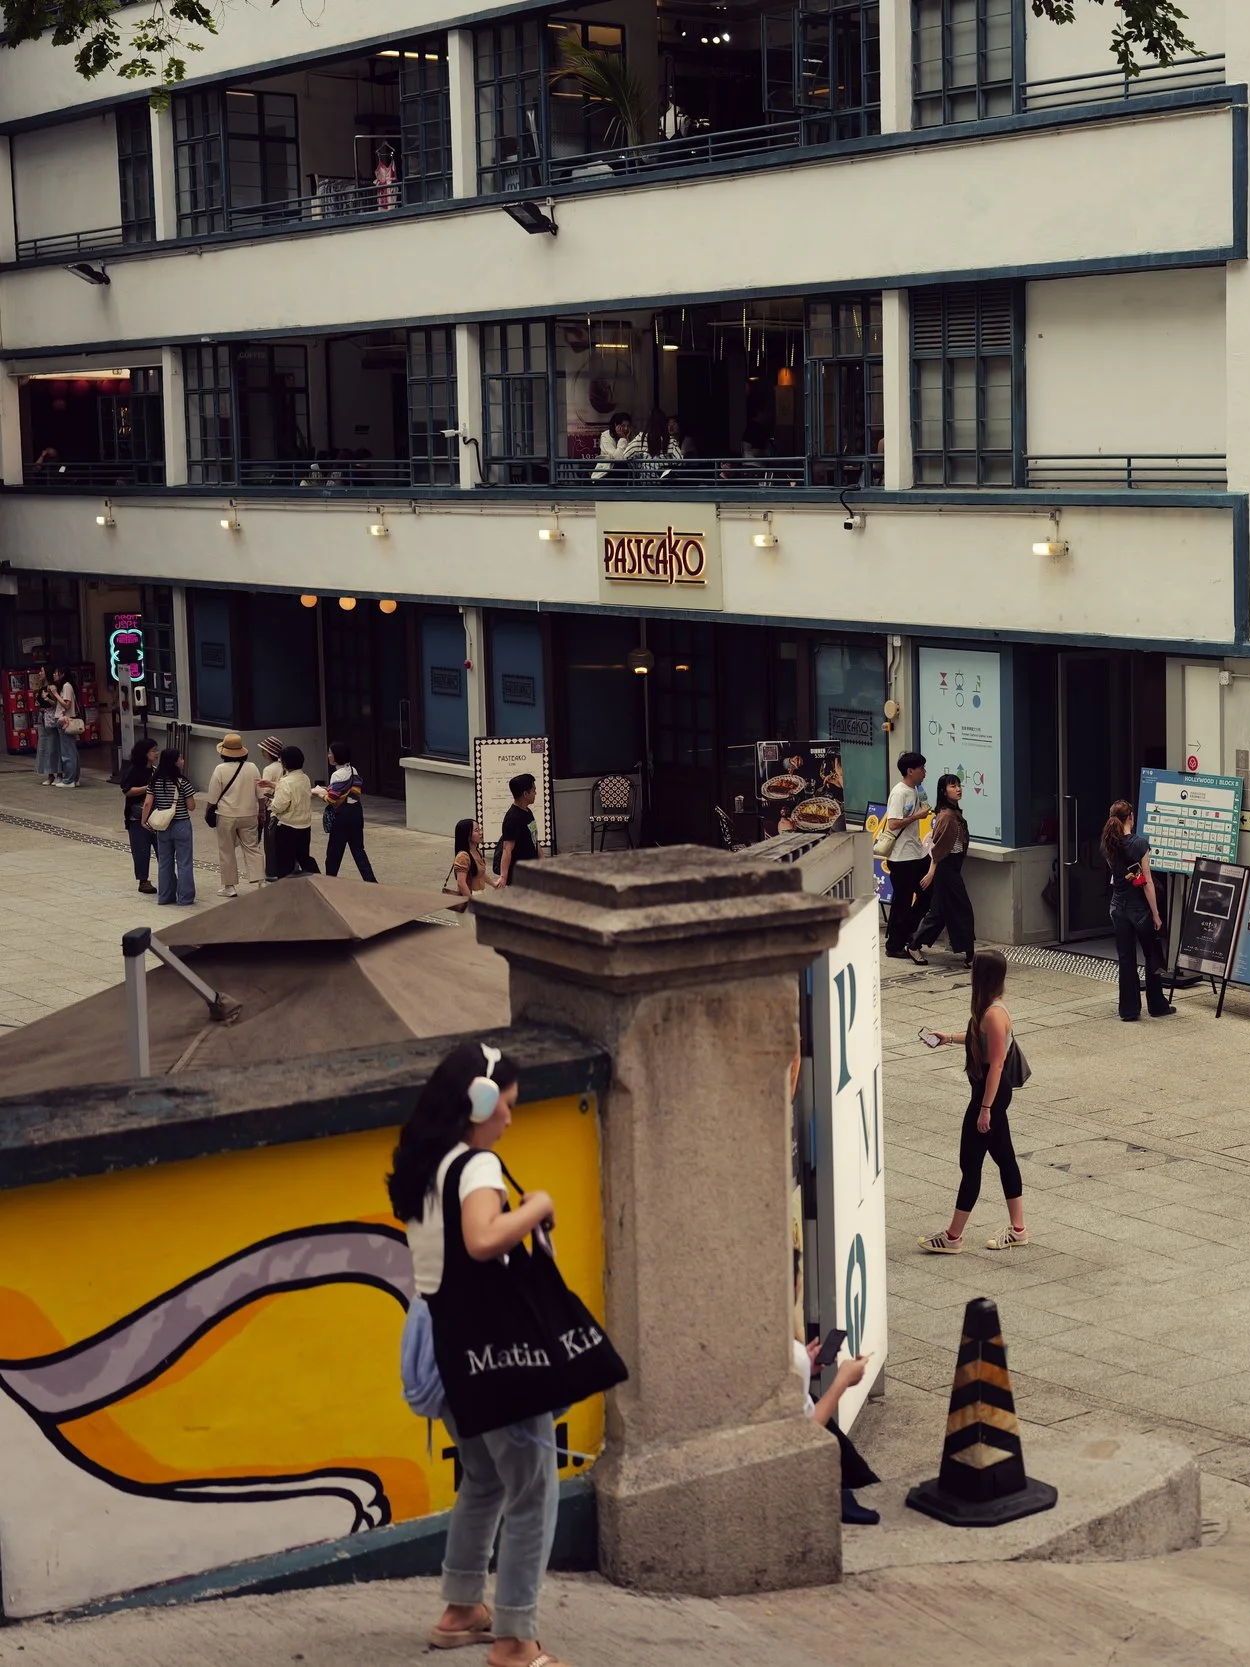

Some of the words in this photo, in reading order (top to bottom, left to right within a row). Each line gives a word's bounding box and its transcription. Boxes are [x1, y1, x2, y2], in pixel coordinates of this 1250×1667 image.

[604, 526, 705, 584] PASTEAKO
[1184, 776, 1214, 784] HOLLYWOOD
[466, 1342, 551, 1376] Matin
